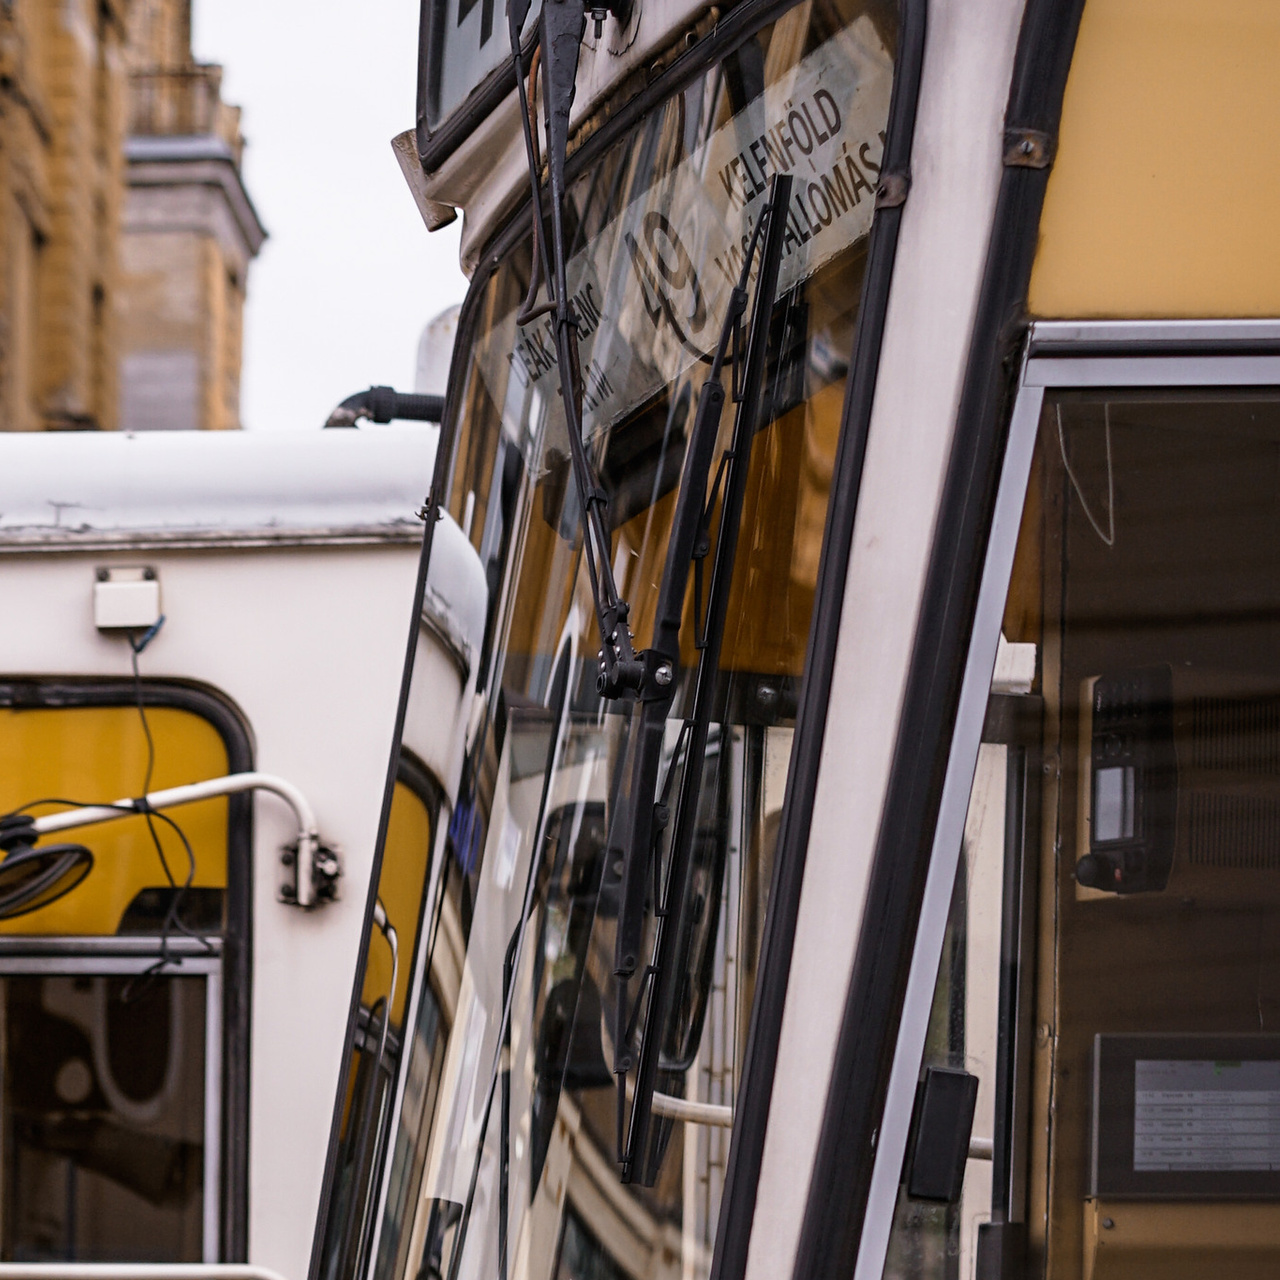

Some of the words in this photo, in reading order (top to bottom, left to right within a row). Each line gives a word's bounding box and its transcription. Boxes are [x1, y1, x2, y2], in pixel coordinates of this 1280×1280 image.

[714, 141, 881, 287] VASÚLLOMÁS
[718, 88, 841, 212] KELENFÖLD
[544, 282, 607, 347] FENC
[624, 211, 707, 343] 49
